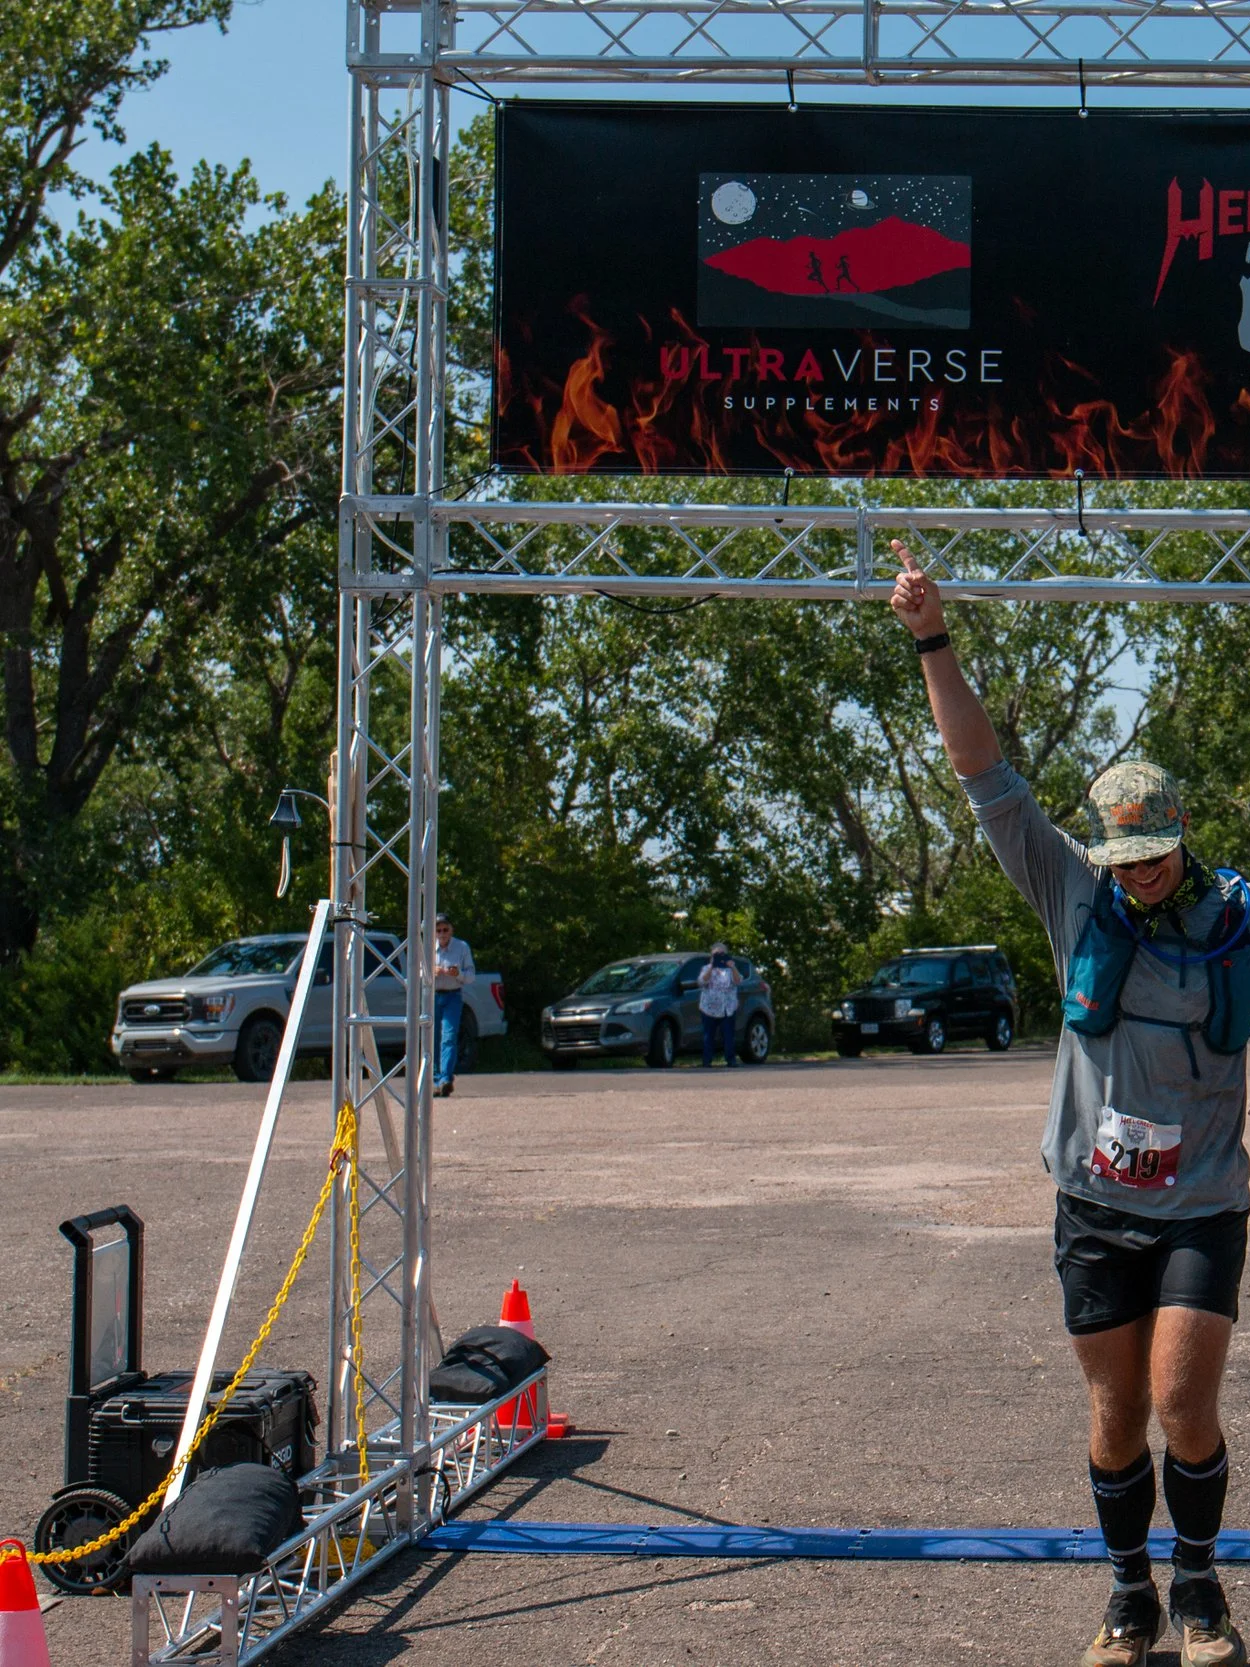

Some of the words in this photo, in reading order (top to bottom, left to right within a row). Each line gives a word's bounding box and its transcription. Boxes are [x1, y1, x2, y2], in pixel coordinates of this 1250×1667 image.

[659, 346, 1004, 383] ULTRAVERSE
[723, 396, 940, 412] SUPPLEMENTS
[1109, 1140, 1160, 1180] 219
